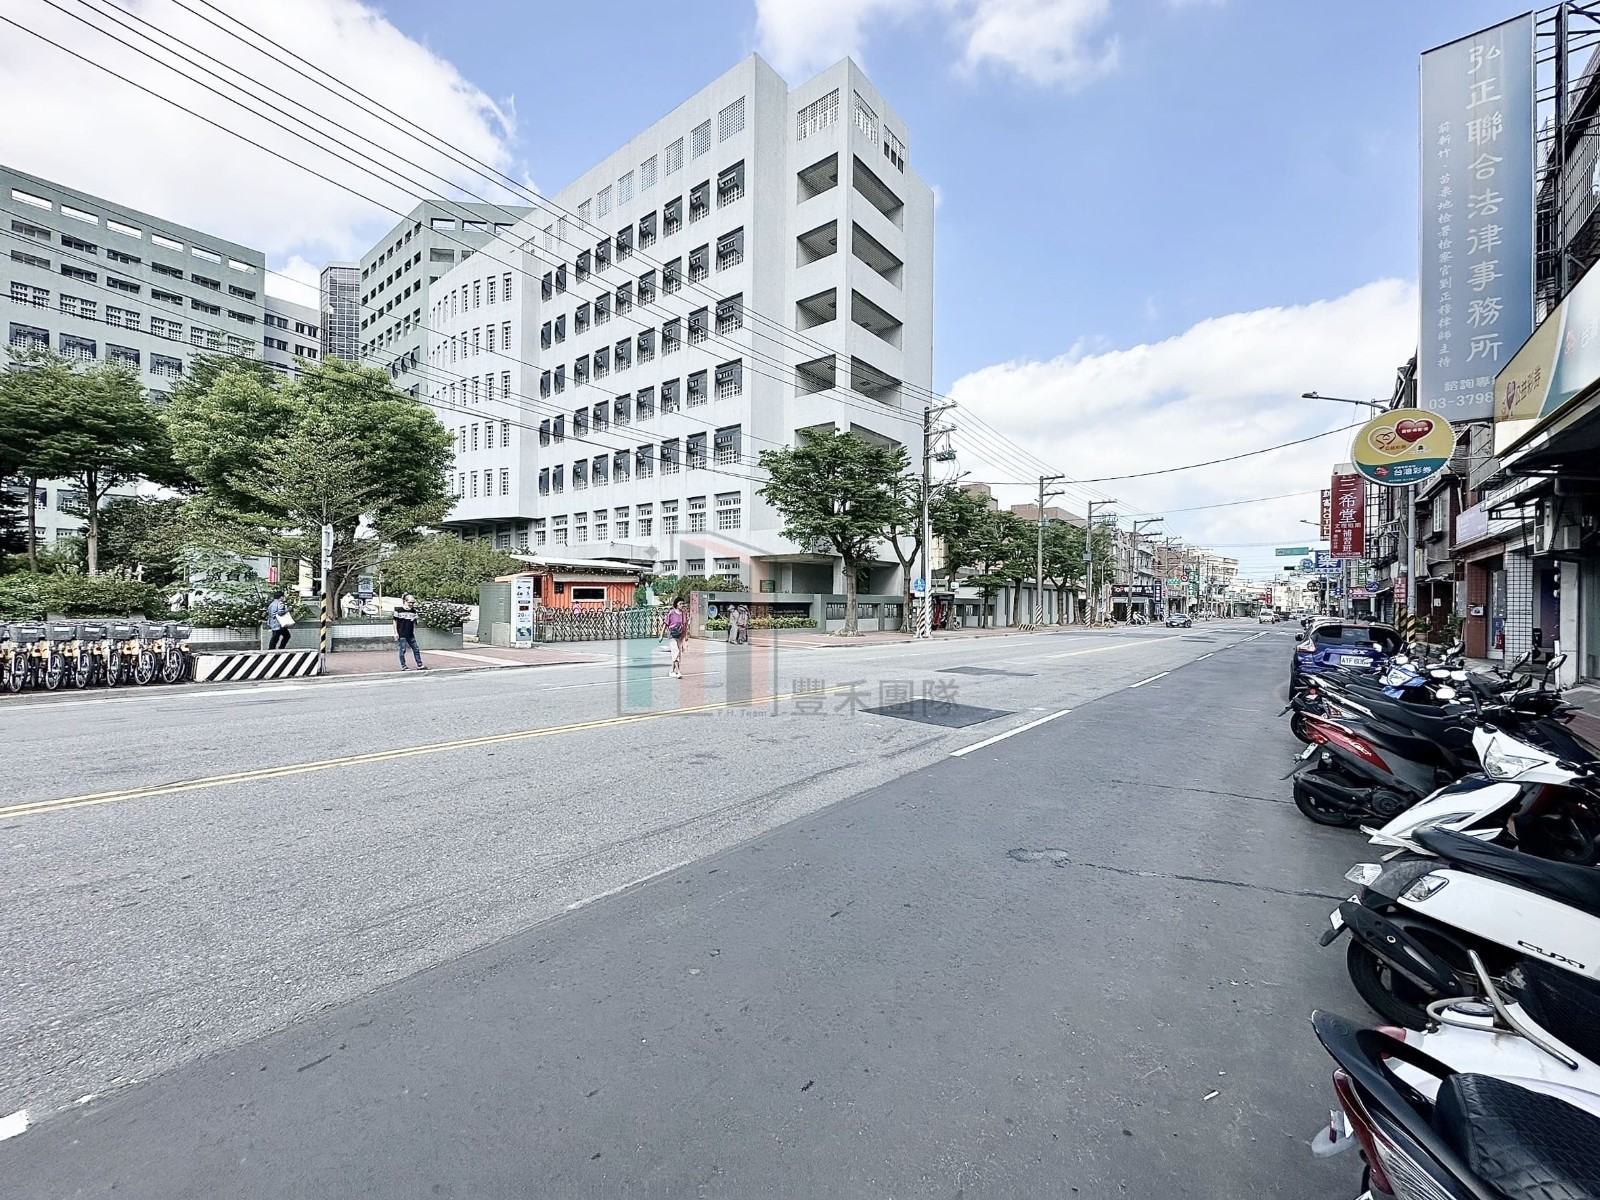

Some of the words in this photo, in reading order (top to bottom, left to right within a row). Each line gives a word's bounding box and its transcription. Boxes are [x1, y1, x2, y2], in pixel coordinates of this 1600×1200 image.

[1466, 44, 1504, 363] 弘正聯合法律事務所
[1444, 376, 1495, 392] 諮詢專
[1338, 478, 1359, 524] 三希堂
